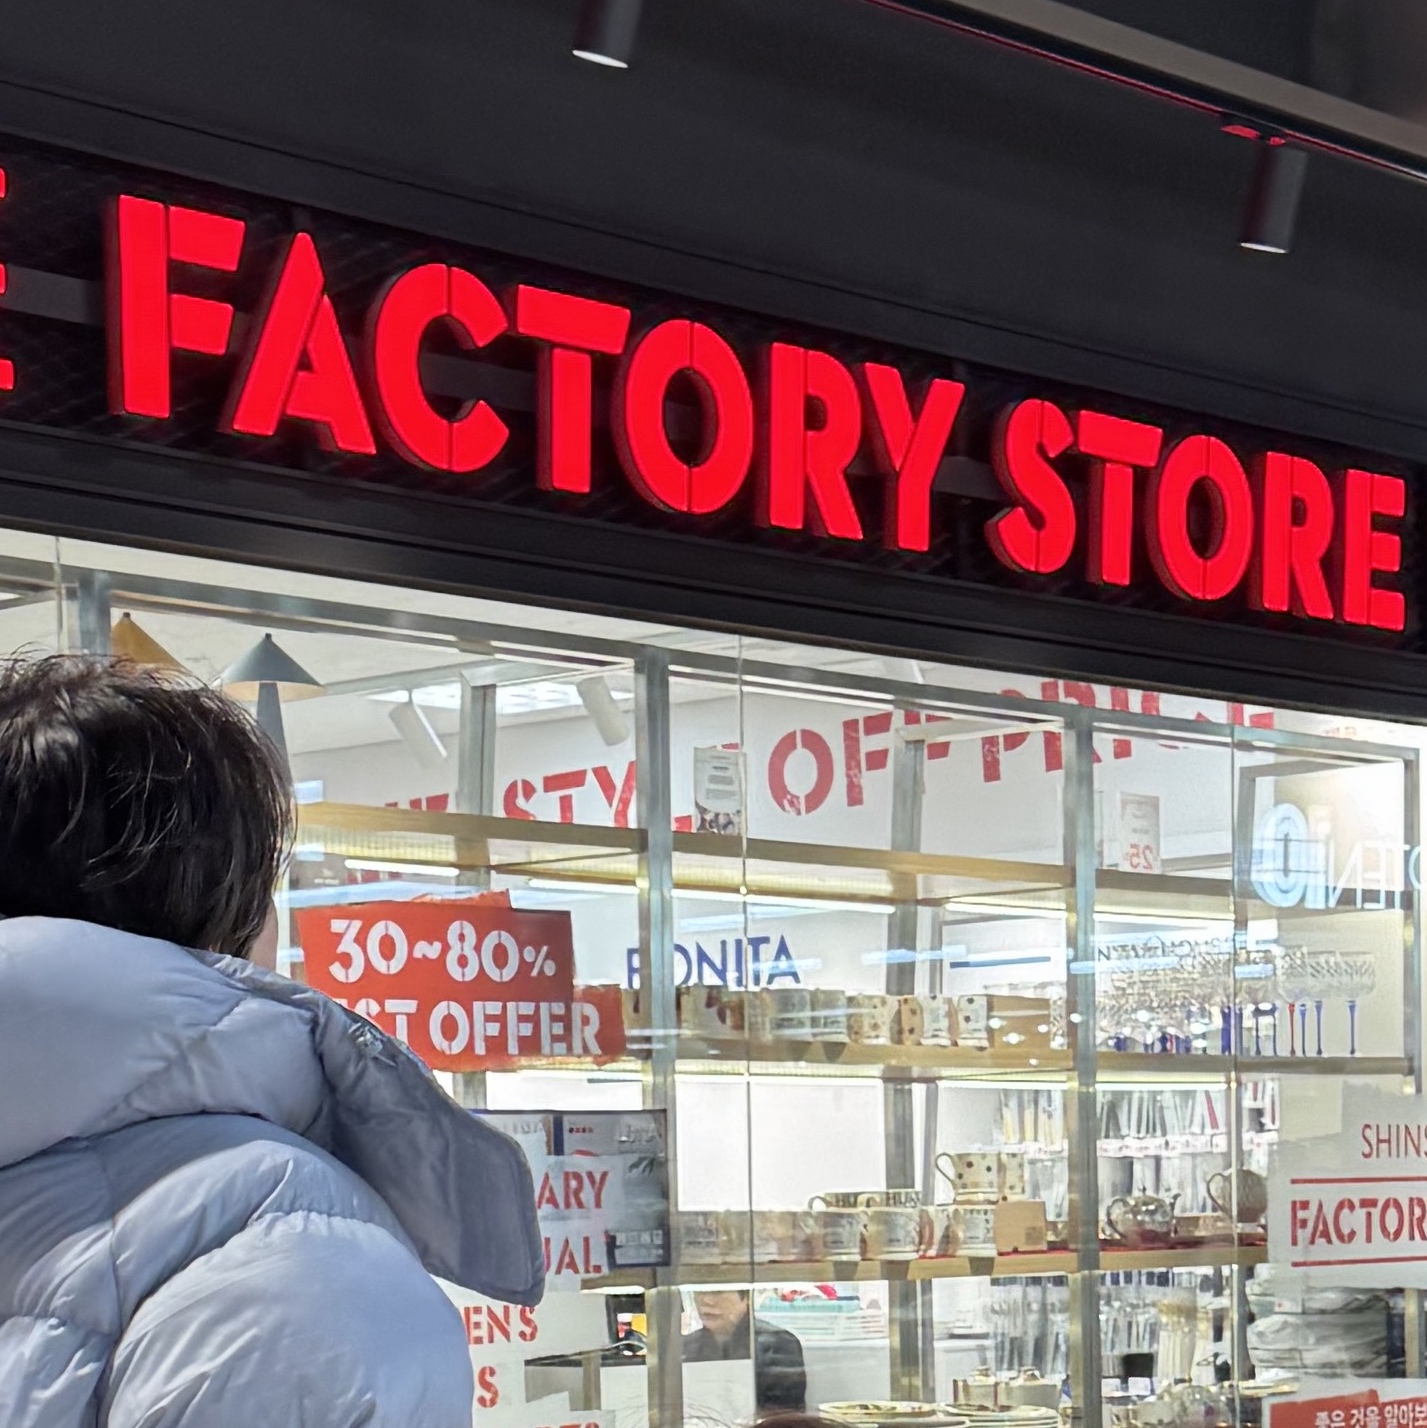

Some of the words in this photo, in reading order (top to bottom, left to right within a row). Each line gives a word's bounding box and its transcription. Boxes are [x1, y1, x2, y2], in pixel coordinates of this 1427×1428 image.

[115, 194, 965, 552] FACTORY
[990, 398, 1406, 632] STORE
[328, 918, 557, 984] 30~80%
[428, 1000, 603, 1057] OFFER
